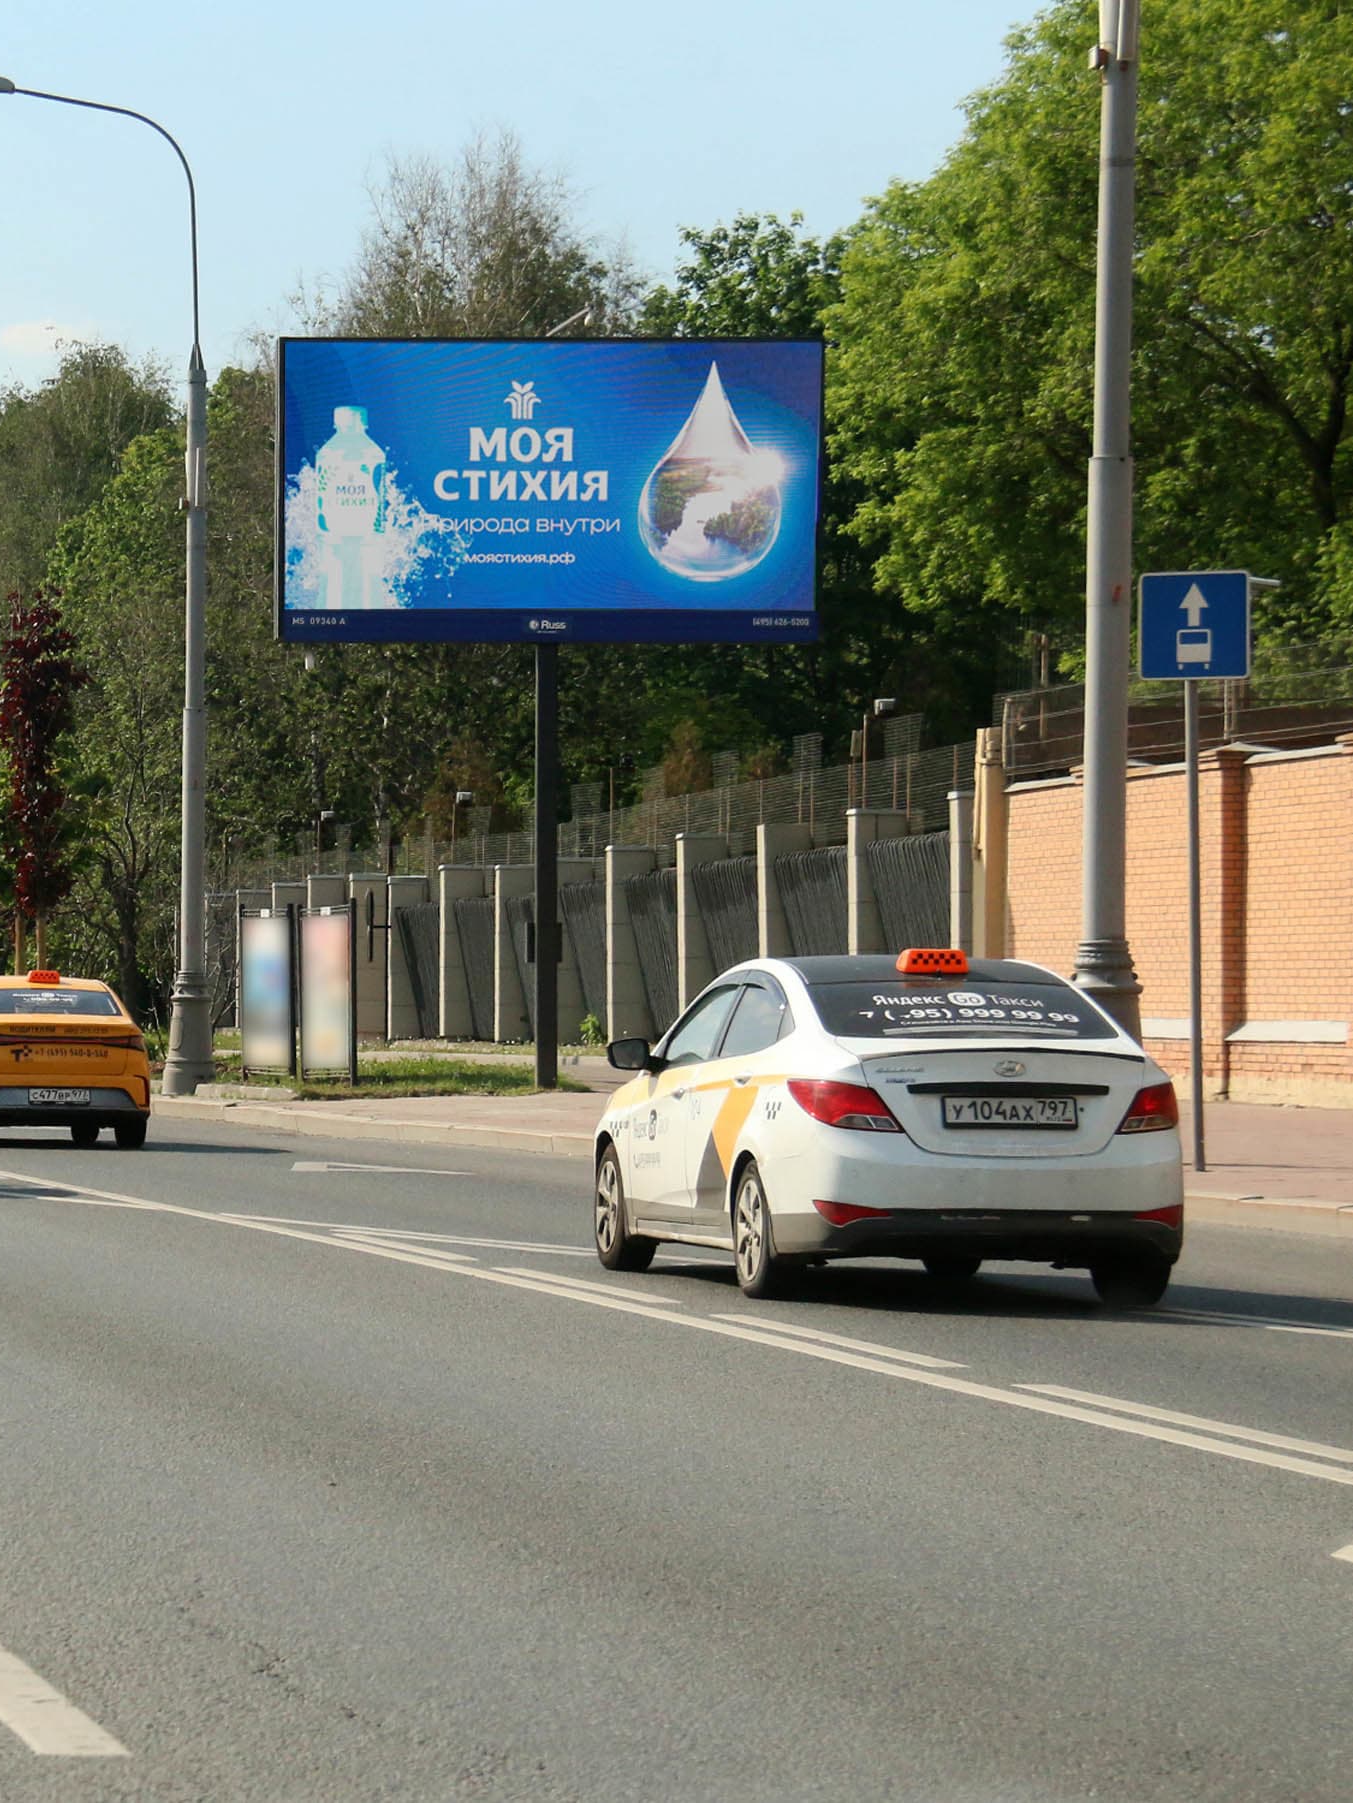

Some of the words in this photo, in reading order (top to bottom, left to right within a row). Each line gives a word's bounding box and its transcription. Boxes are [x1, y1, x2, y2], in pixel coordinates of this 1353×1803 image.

[469, 427, 574, 463] МОЯ
[433, 469, 609, 501] СТИХИЯ
[425, 517, 530, 535] рирода
[536, 517, 621, 536] внутри
[463, 552, 576, 566] моястихия.рф
[541, 620, 567, 630] Russ
[872, 994, 946, 1006] Яндекс
[986, 994, 1044, 1008] Такси
[884, 1008, 952, 1021] (95)
[958, 1008, 1006, 1019] 999
[1011, 1010, 1044, 1021] 99
[1048, 1012, 1080, 1023] 99
